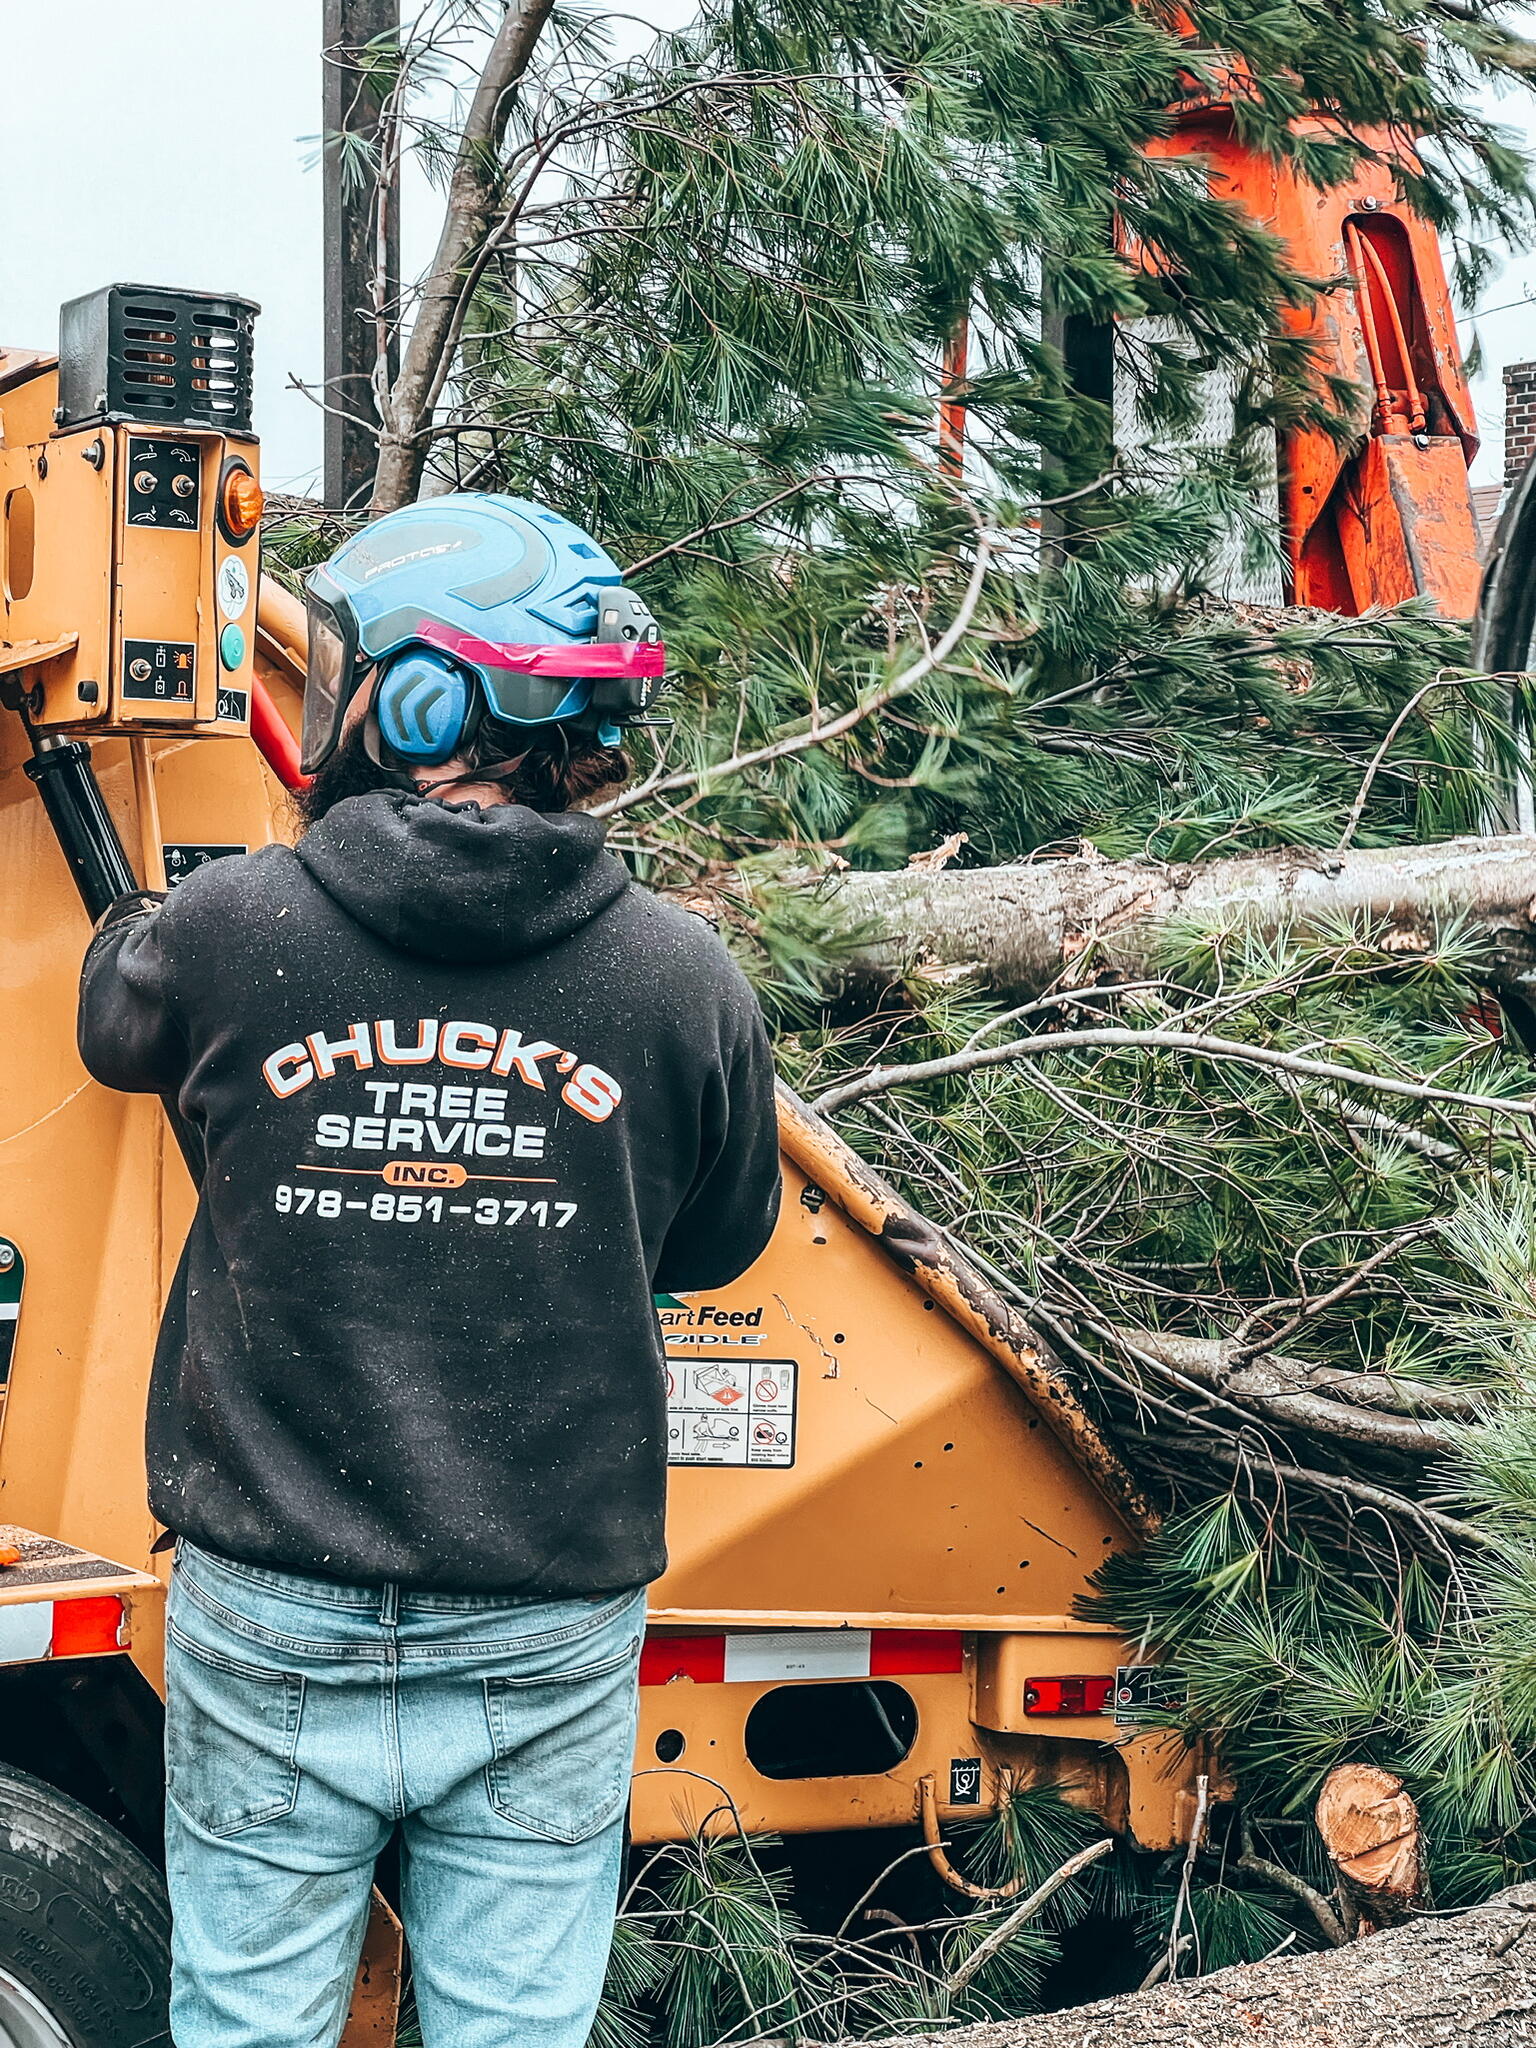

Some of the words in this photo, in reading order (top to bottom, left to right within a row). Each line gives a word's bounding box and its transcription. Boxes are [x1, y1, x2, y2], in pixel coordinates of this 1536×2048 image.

[262, 1018, 624, 1123] CHUCK'S
[364, 1080, 509, 1121] TREE
[315, 1113, 547, 1159] SERVICE
[392, 1165, 456, 1184] INC.
[274, 1184, 578, 1228] 978-851-3717
